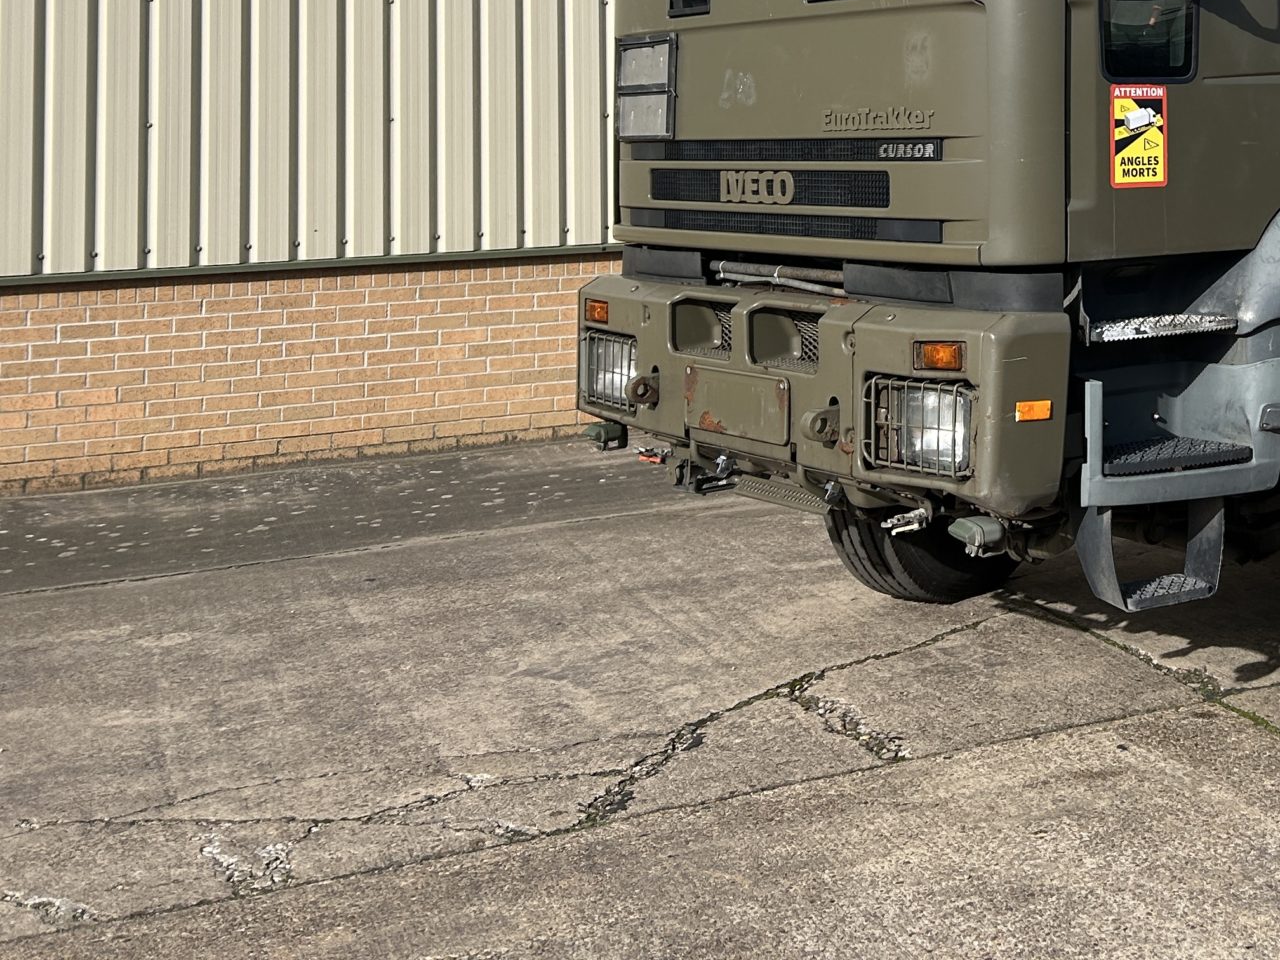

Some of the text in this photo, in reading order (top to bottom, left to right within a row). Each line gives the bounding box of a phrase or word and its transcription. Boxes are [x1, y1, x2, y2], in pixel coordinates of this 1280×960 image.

[1113, 87, 1164, 97] ATTENTION
[822, 106, 935, 133] EuroTrakker
[878, 143, 935, 158] CURSOR
[1119, 155, 1160, 167] ANGLES
[1122, 167, 1158, 178] MORTS
[720, 170, 795, 205] IVECO
